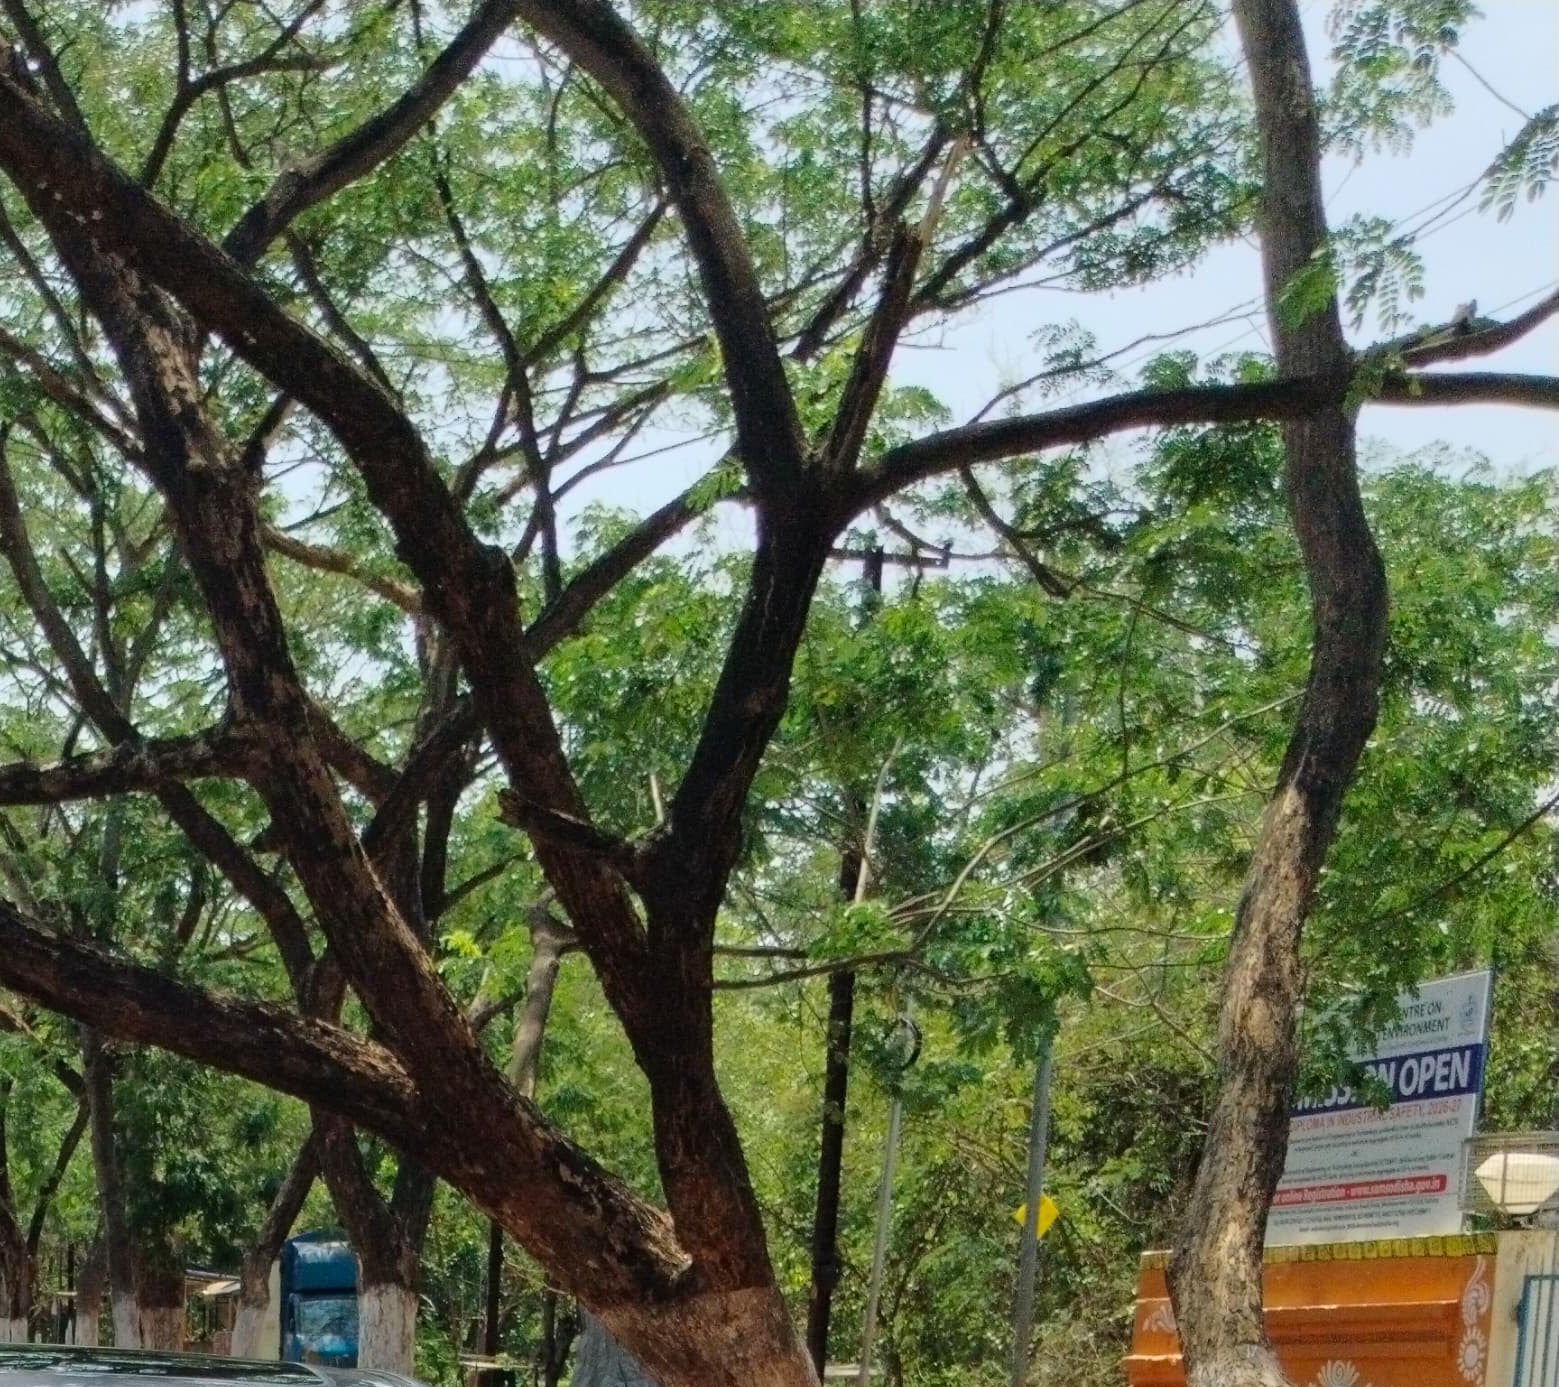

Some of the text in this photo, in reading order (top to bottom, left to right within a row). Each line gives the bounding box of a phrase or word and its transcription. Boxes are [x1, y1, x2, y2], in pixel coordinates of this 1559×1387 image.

[1427, 1001, 1442, 1016] ON
[1382, 1017, 1450, 1041] ENVIRONMENT
[1399, 1050, 1471, 1096] OPEN
